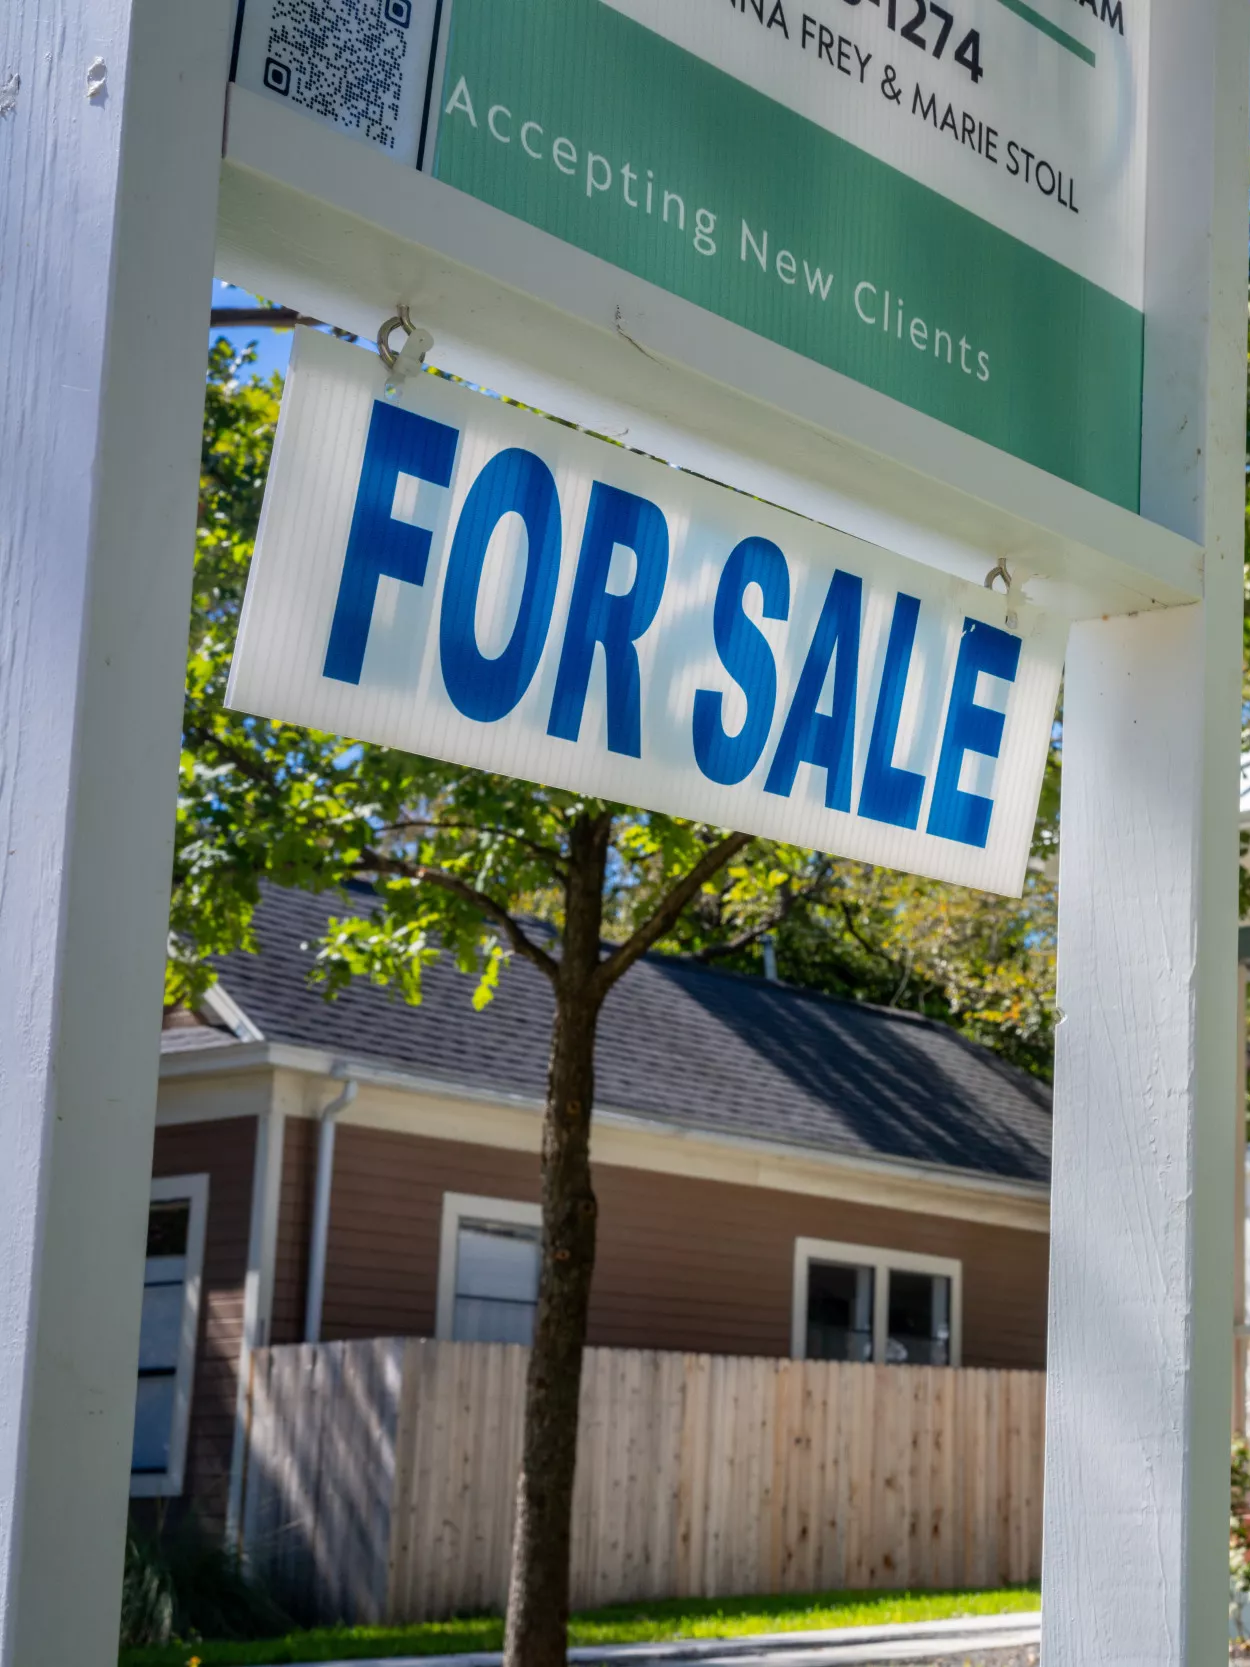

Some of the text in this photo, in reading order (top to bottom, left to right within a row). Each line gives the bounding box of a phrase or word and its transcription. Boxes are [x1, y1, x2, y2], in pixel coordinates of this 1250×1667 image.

[444, 75, 991, 383] Accepting New Clients
[801, 13, 872, 83] FREY
[880, 64, 901, 105] &
[911, 82, 999, 164] MARIE
[1005, 140, 1080, 214] STOLL
[322, 399, 1023, 850] FOR SALE
